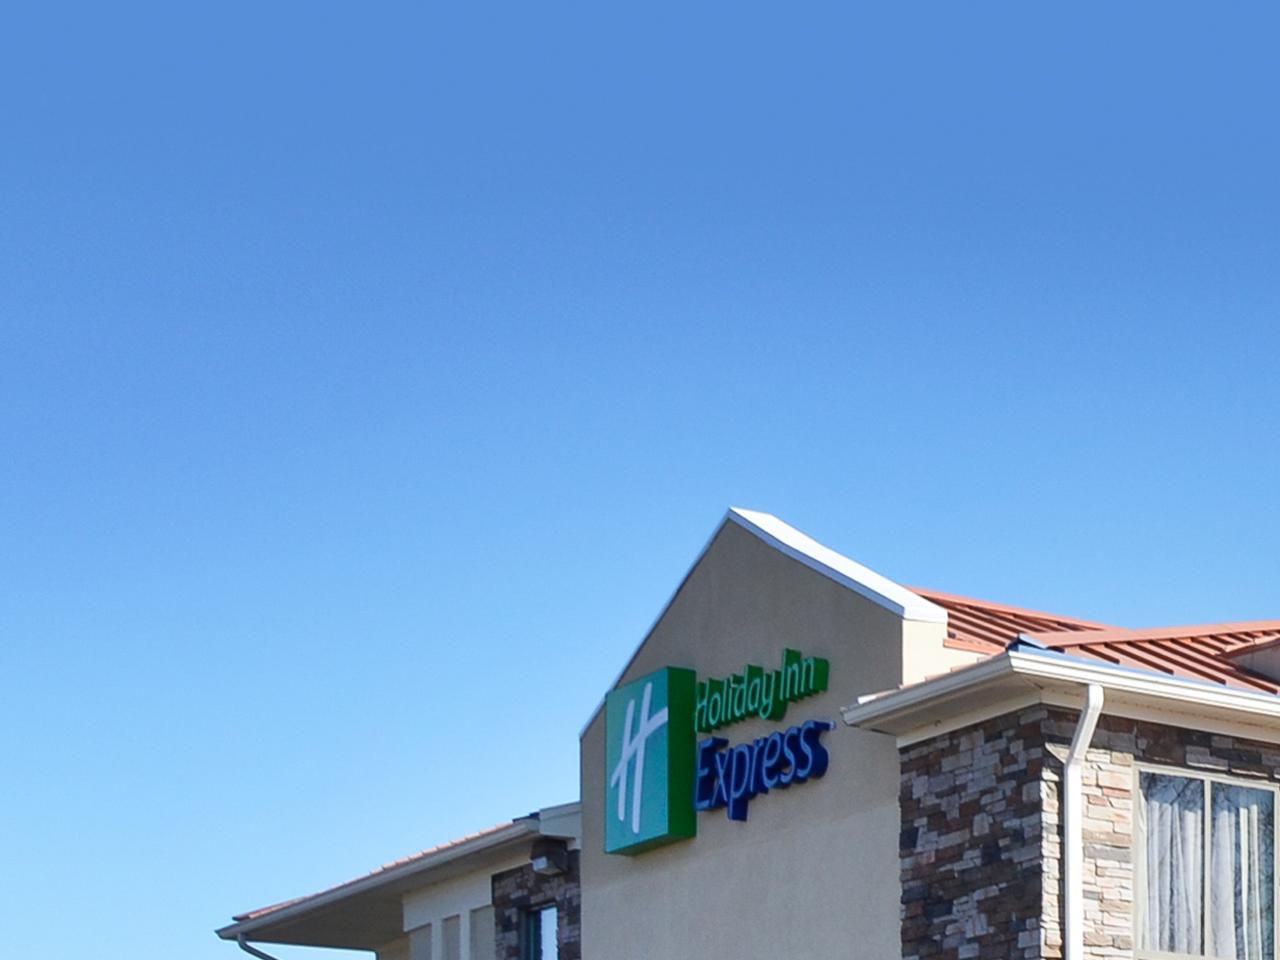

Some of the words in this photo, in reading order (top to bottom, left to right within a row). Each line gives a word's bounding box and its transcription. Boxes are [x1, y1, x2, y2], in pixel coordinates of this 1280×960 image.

[694, 663, 786, 735] Holiday
[779, 648, 829, 702] Inn
[694, 719, 832, 822] Express
